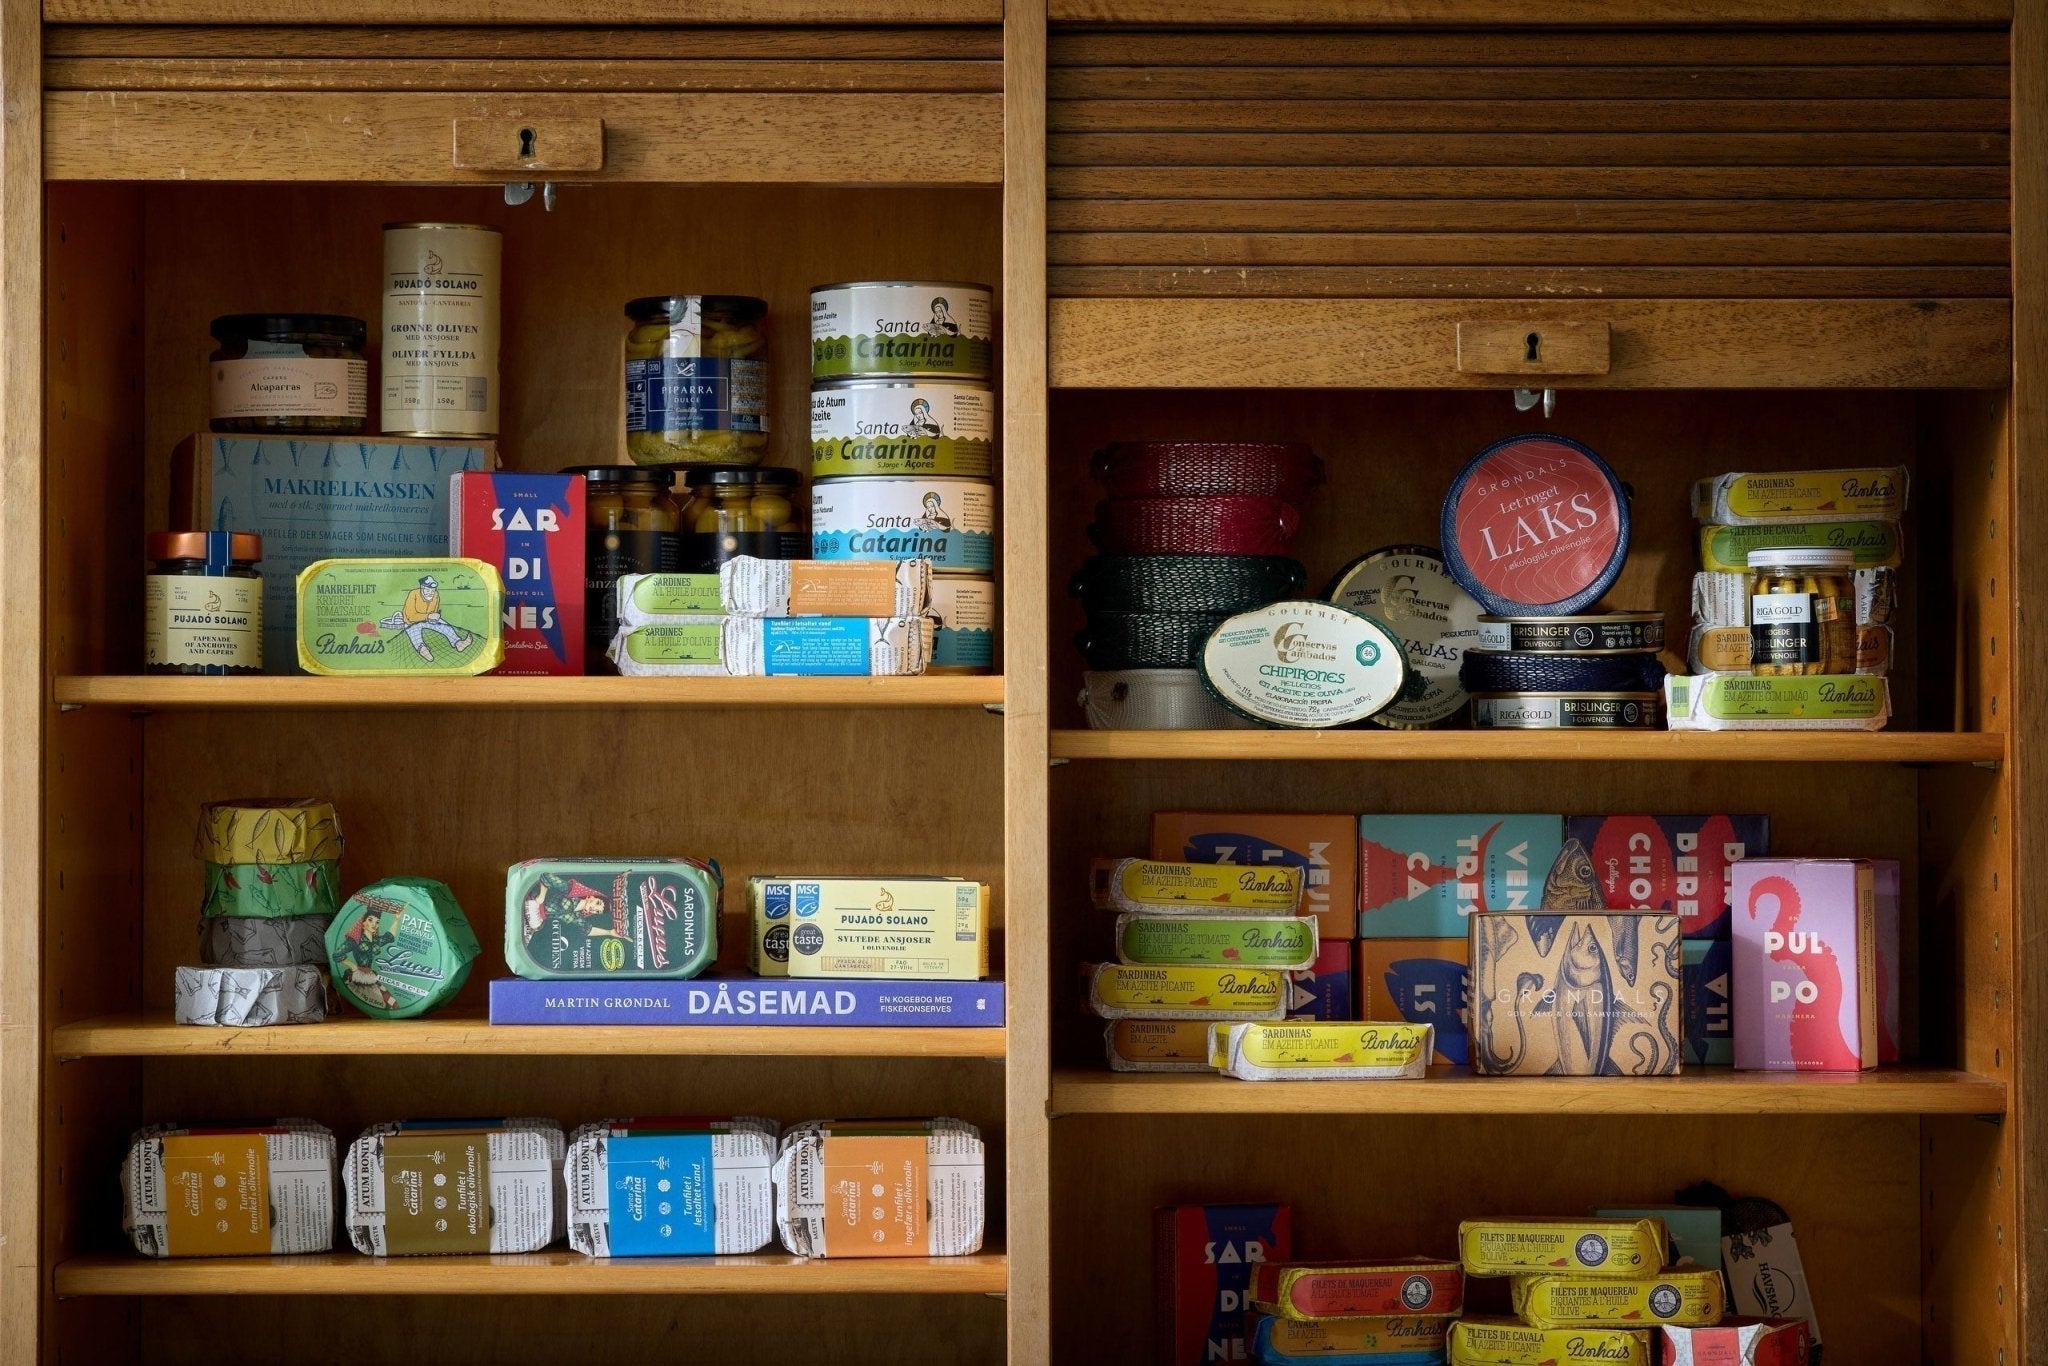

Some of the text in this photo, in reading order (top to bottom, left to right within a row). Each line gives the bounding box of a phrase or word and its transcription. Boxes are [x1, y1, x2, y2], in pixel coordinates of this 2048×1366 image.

[394, 277, 477, 289] PUJADÓ SOLANO
[391, 325, 478, 333] GRØNNE OLIVEN
[875, 319, 919, 332] Santa
[857, 338, 955, 358] Catarina
[434, 351, 475, 359] FYLLDA
[251, 383, 300, 392] Alcaparras
[662, 386, 713, 394] PIPARRA
[817, 397, 845, 407] de Atum
[855, 421, 898, 434] Santa
[841, 439, 936, 460] Catarina
[905, 460, 935, 469] Açores
[1478, 459, 1567, 496] GRØNDALS
[1747, 479, 1794, 488] SARDINHAS
[264, 478, 435, 499] MAKRELKASSEN
[1842, 478, 1895, 498] Pinhais
[1500, 485, 1560, 514] Let røget
[491, 507, 560, 532] SAR
[867, 514, 911, 527] Santa
[1480, 493, 1597, 561] LAKS
[1730, 525, 1806, 536] FILETES DE CAVALA
[850, 533, 947, 553] Catarina
[1828, 528, 1887, 547] Pinhais
[509, 558, 540, 579] DI
[654, 578, 691, 586] SARDINES
[316, 585, 376, 594] MAKRELFILET
[316, 595, 354, 605] KRYDRET
[316, 606, 370, 616] TOMATSAUCE
[1268, 609, 1349, 625] GOURMET
[1757, 606, 1802, 616] RIGA GOLD
[175, 613, 247, 625] PUJADÓ SOLANO
[646, 628, 683, 636] SARDINES
[1514, 627, 1570, 636] BRISLINGER
[316, 633, 385, 654] Pinhais
[535, 641, 548, 649] Sea
[1488, 634, 1505, 643] GOLD
[1259, 665, 1345, 684] CHIPIRONES
[1259, 680, 1270, 688] EN
[1272, 686, 1301, 696] ACEITE
[1724, 681, 1772, 690] SARDINHAS
[1724, 688, 1808, 701] EM AZEITE COM LIMÃO
[1565, 703, 1620, 712] BRISLINGER
[1500, 711, 1551, 720] RIGA GOLD
[1491, 855, 1495, 865] DE
[1142, 865, 1191, 875] SARDINHAS
[1456, 835, 1478, 917] TRES
[1677, 833, 1699, 915] BERE
[1142, 876, 1217, 889] EM AZEITE PICANTE
[1308, 842, 1331, 912] MEJI
[1407, 852, 1431, 902] CA
[767, 886, 790, 895] MSC
[797, 886, 818, 894] MSC
[403, 914, 432, 932] PATÉ
[684, 888, 694, 955] SARDINHAS
[842, 914, 928, 925] PUJADÓ SOLANO
[401, 925, 434, 941] DE CAVALA
[1137, 923, 1189, 933] SARDINHAS
[586, 939, 591, 948] EM
[794, 935, 823, 945] taste
[883, 936, 931, 944] ANSJOSER
[1764, 932, 1823, 954] PUL
[1117, 970, 1167, 979] SARDINHAS
[1117, 981, 1195, 992] EM AZEITE PICANTE
[1771, 981, 1818, 1003] PO
[545, 998, 670, 1008] MARTIN GRØNDAL
[688, 983, 857, 1015] DÅSEMAD
[1498, 989, 1664, 1004] GRØNDALS
[1130, 1024, 1176, 1034] SARDINHAS
[1263, 1029, 1311, 1038] SARDINHAS
[190, 1172, 199, 1216] Catarina
[239, 1176, 247, 1211] Tunfilet
[458, 1176, 466, 1211] Tunfilet
[466, 1145, 476, 1234] økologisk olivenolie
[693, 1164, 702, 1226] letsaltet vand
[634, 1177, 642, 1221] Catarina
[684, 1181, 692, 1216] Tunfilet
[848, 1182, 856, 1226] Catarina
[1480, 1233, 1564, 1243] FILETS DE MAQUEREAU
[1204, 1240, 1267, 1264] SAR
[1551, 1287, 1638, 1296] FILETS DE MAQUEREAU
[1551, 1307, 1580, 1315] D'OLIVE
[1467, 1329, 1544, 1342] FILETES DE CAVALA
